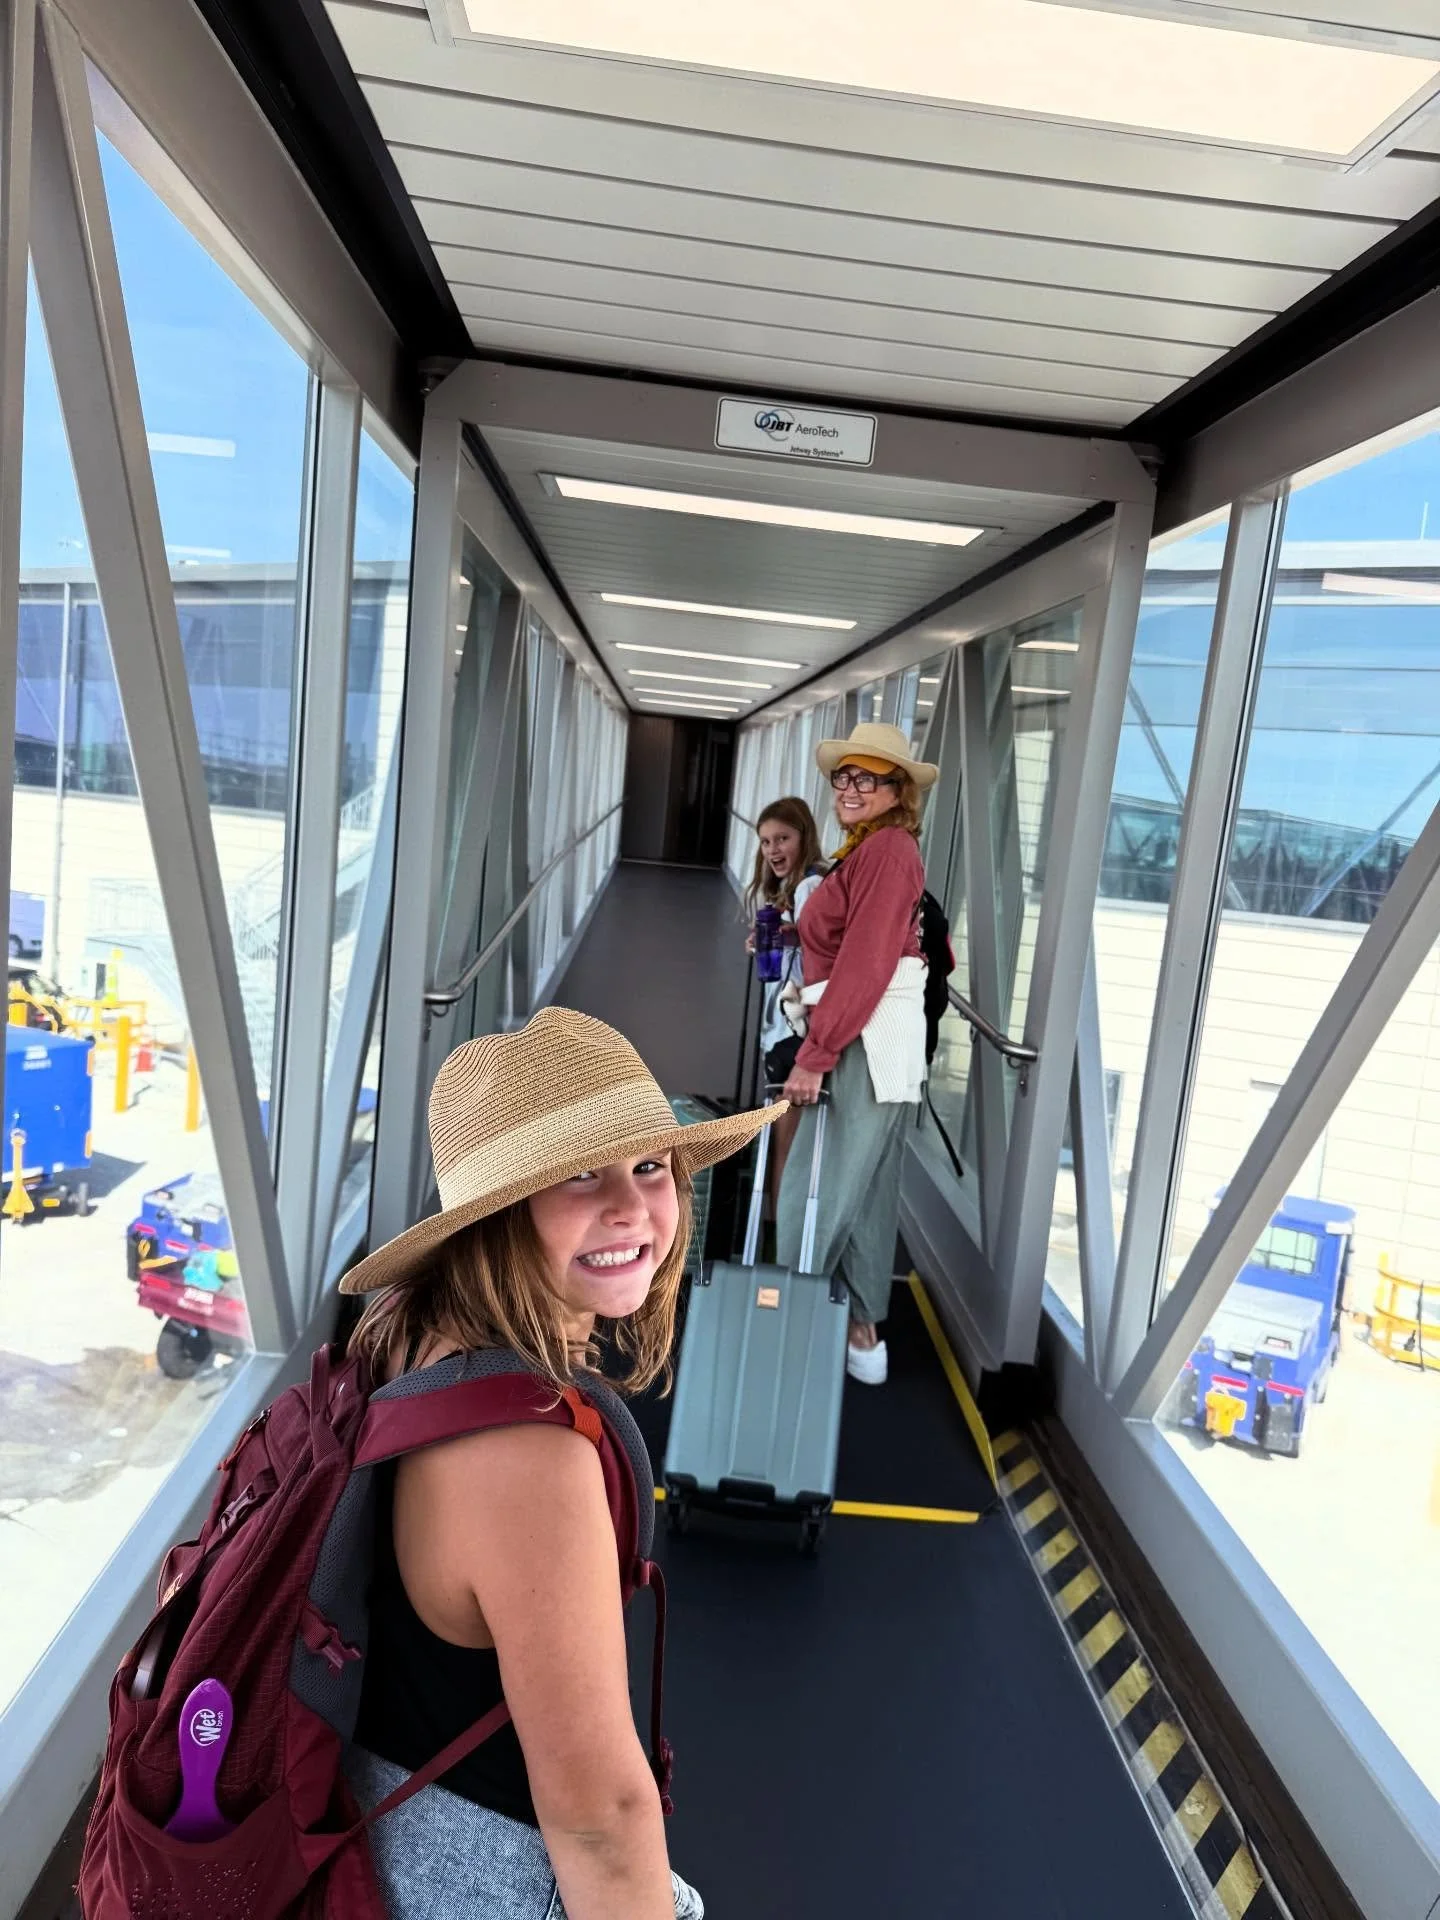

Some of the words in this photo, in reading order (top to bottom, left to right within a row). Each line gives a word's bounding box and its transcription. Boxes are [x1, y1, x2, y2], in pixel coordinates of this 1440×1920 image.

[769, 420, 794, 432] JBT
[795, 424, 839, 438] AeroTech
[195, 1710, 221, 1742] Wet
[216, 1711, 224, 1727] brush
